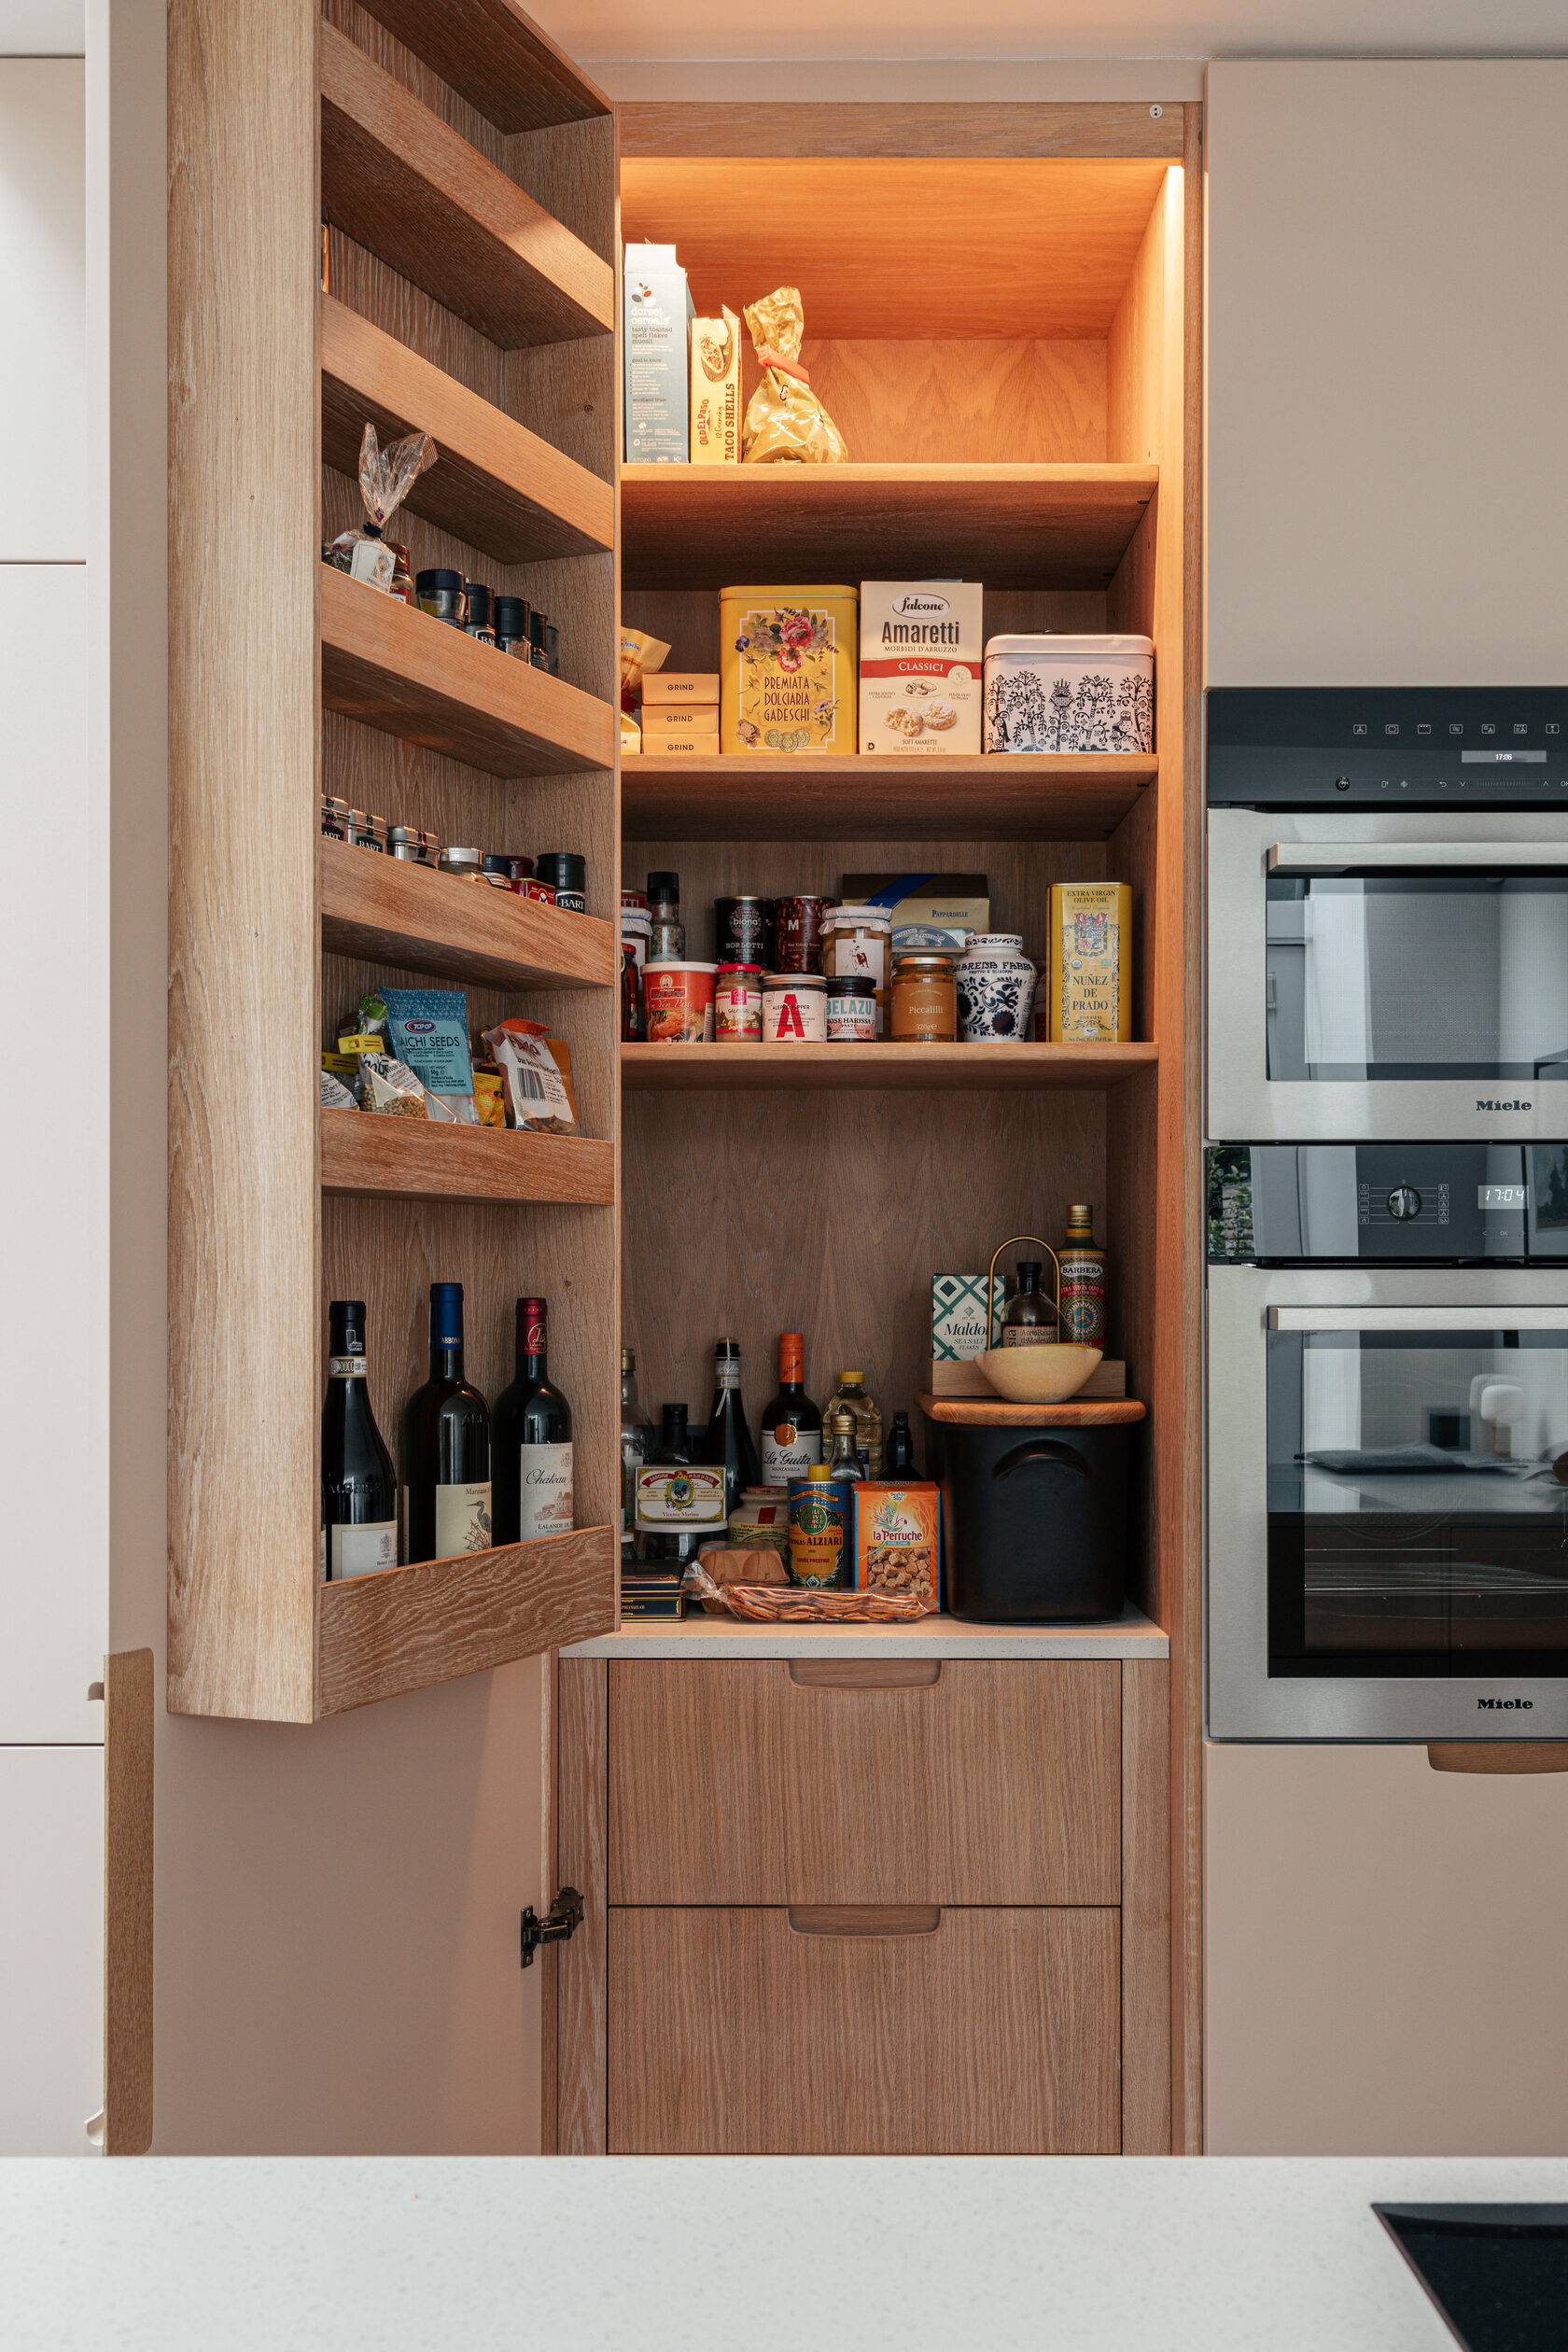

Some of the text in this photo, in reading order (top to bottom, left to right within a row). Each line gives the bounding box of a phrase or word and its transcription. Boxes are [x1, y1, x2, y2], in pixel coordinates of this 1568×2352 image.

[631, 306, 664, 316] dorset
[631, 316, 669, 325] cereals
[697, 419, 707, 430] EL
[724, 383, 735, 461] TACO SHELLS
[699, 429, 709, 446] OLD
[900, 596, 945, 613] falcone
[881, 621, 960, 645] Amaretti
[898, 661, 944, 672] CLASSICI
[764, 676, 810, 690] PREMIATA
[764, 692, 810, 706] DOLCIARIA
[763, 708, 810, 722] GADESCHI
[1494, 753, 1513, 762] 17:06
[733, 917, 759, 925] biona
[787, 919, 800, 931] M
[1072, 973, 1109, 986] NUÑEZ
[1083, 987, 1098, 998] DE
[826, 999, 872, 1016] BELAZU
[908, 1005, 944, 1015] Piccalilli
[1072, 1000, 1109, 1011] PRADO
[429, 1036, 460, 1047] SEEDS
[1476, 1099, 1533, 1112] Miele
[1485, 1188, 1526, 1202] 17:04
[763, 1449, 812, 1465] La Guita
[805, 1536, 843, 1547] ALZIARI
[873, 1530, 923, 1542] la Perruche
[1477, 1698, 1533, 1710] Miele
